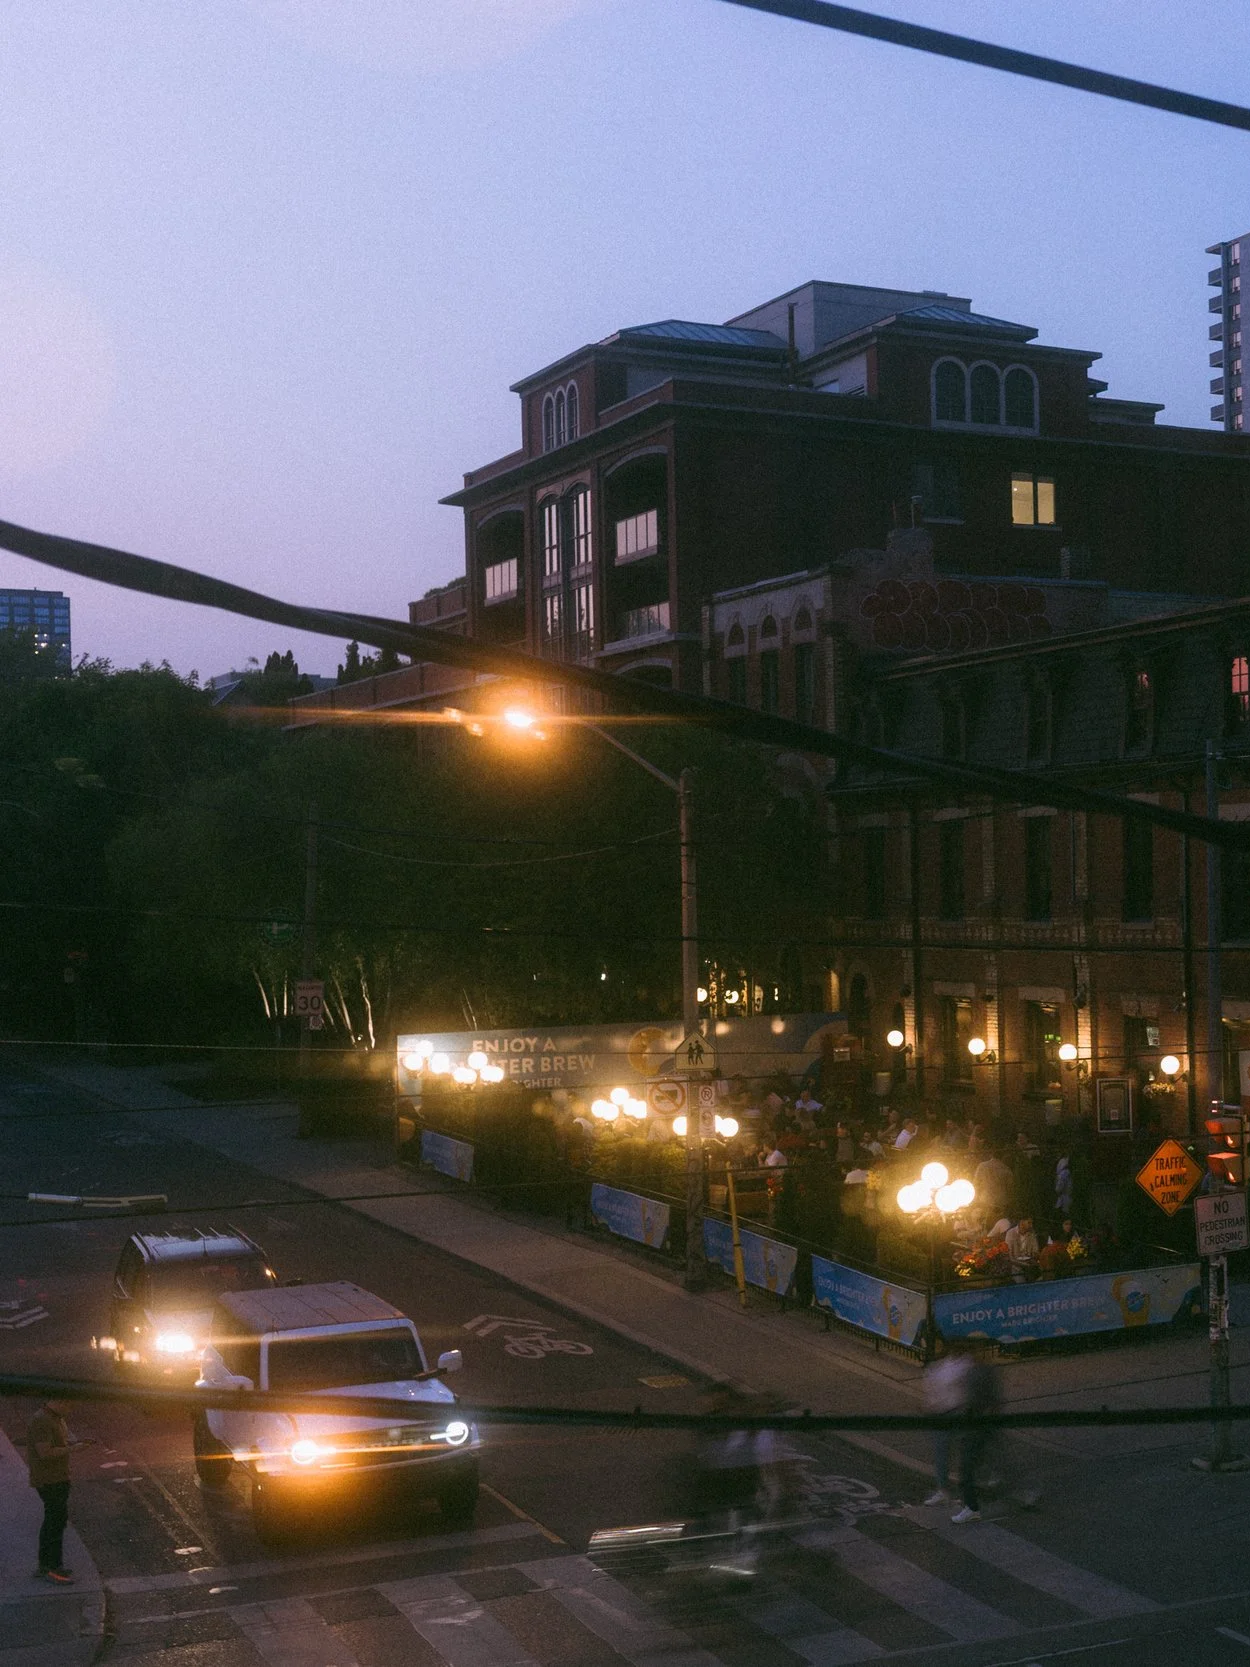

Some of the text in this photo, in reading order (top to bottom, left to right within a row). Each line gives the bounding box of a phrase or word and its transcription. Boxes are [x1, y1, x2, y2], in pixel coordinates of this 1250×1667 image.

[299, 996, 320, 1010] 30
[472, 1037, 557, 1053] ENJOY A
[540, 1054, 596, 1073] BREW
[1155, 1156, 1187, 1171] TRAFFIC
[1154, 1172, 1188, 1188] CALMING
[1160, 1190, 1181, 1204] ZONE
[1213, 1201, 1229, 1214] NO
[1200, 1216, 1246, 1232] PEDESTRIAN
[1204, 1231, 1243, 1246] CROSSING
[952, 1309, 993, 1325] ENJOY
[995, 1307, 1005, 1320] A
[1007, 1299, 1069, 1318] BRIGHTER
